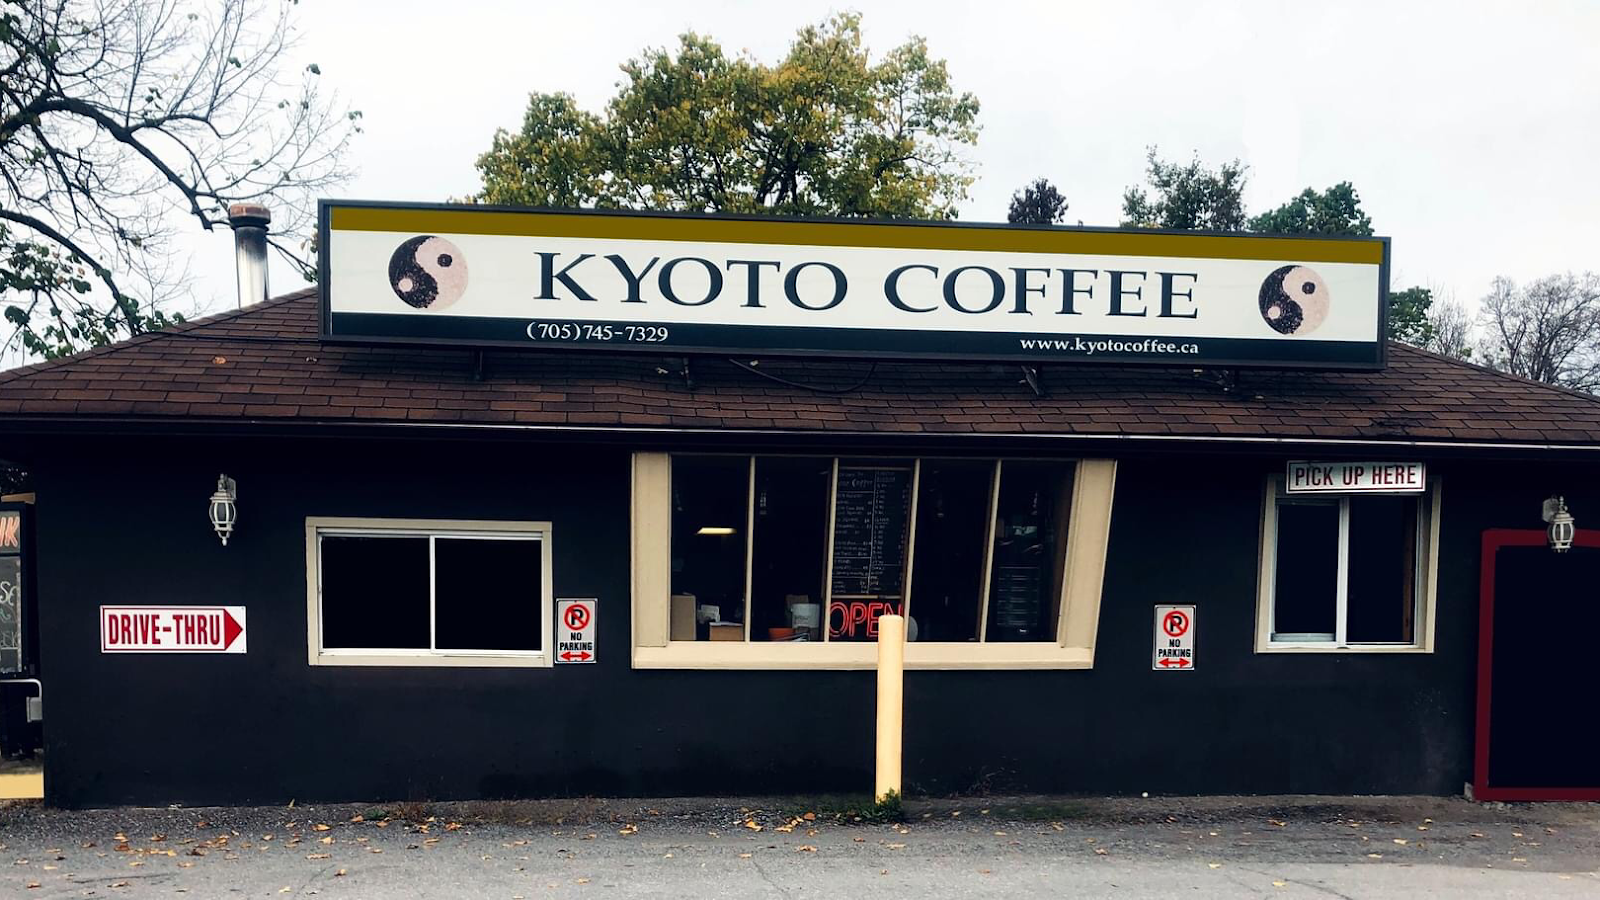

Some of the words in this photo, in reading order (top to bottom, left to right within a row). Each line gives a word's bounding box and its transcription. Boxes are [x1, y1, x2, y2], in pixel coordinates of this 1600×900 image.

[533, 251, 848, 311] KYOTO
[884, 264, 1198, 319] COFFEE
[526, 321, 669, 342] (705)745-7329
[1020, 337, 1199, 355] www.kyotocoffee.ca
[1295, 466, 1333, 486] PICK
[1343, 466, 1364, 486] UP
[1372, 465, 1416, 484] HERE
[108, 614, 220, 645] DRIVE-THRU
[570, 632, 582, 641] NO
[559, 642, 593, 651] PARKING
[1169, 639, 1180, 648] NO
[1158, 649, 1191, 658] PARKING
